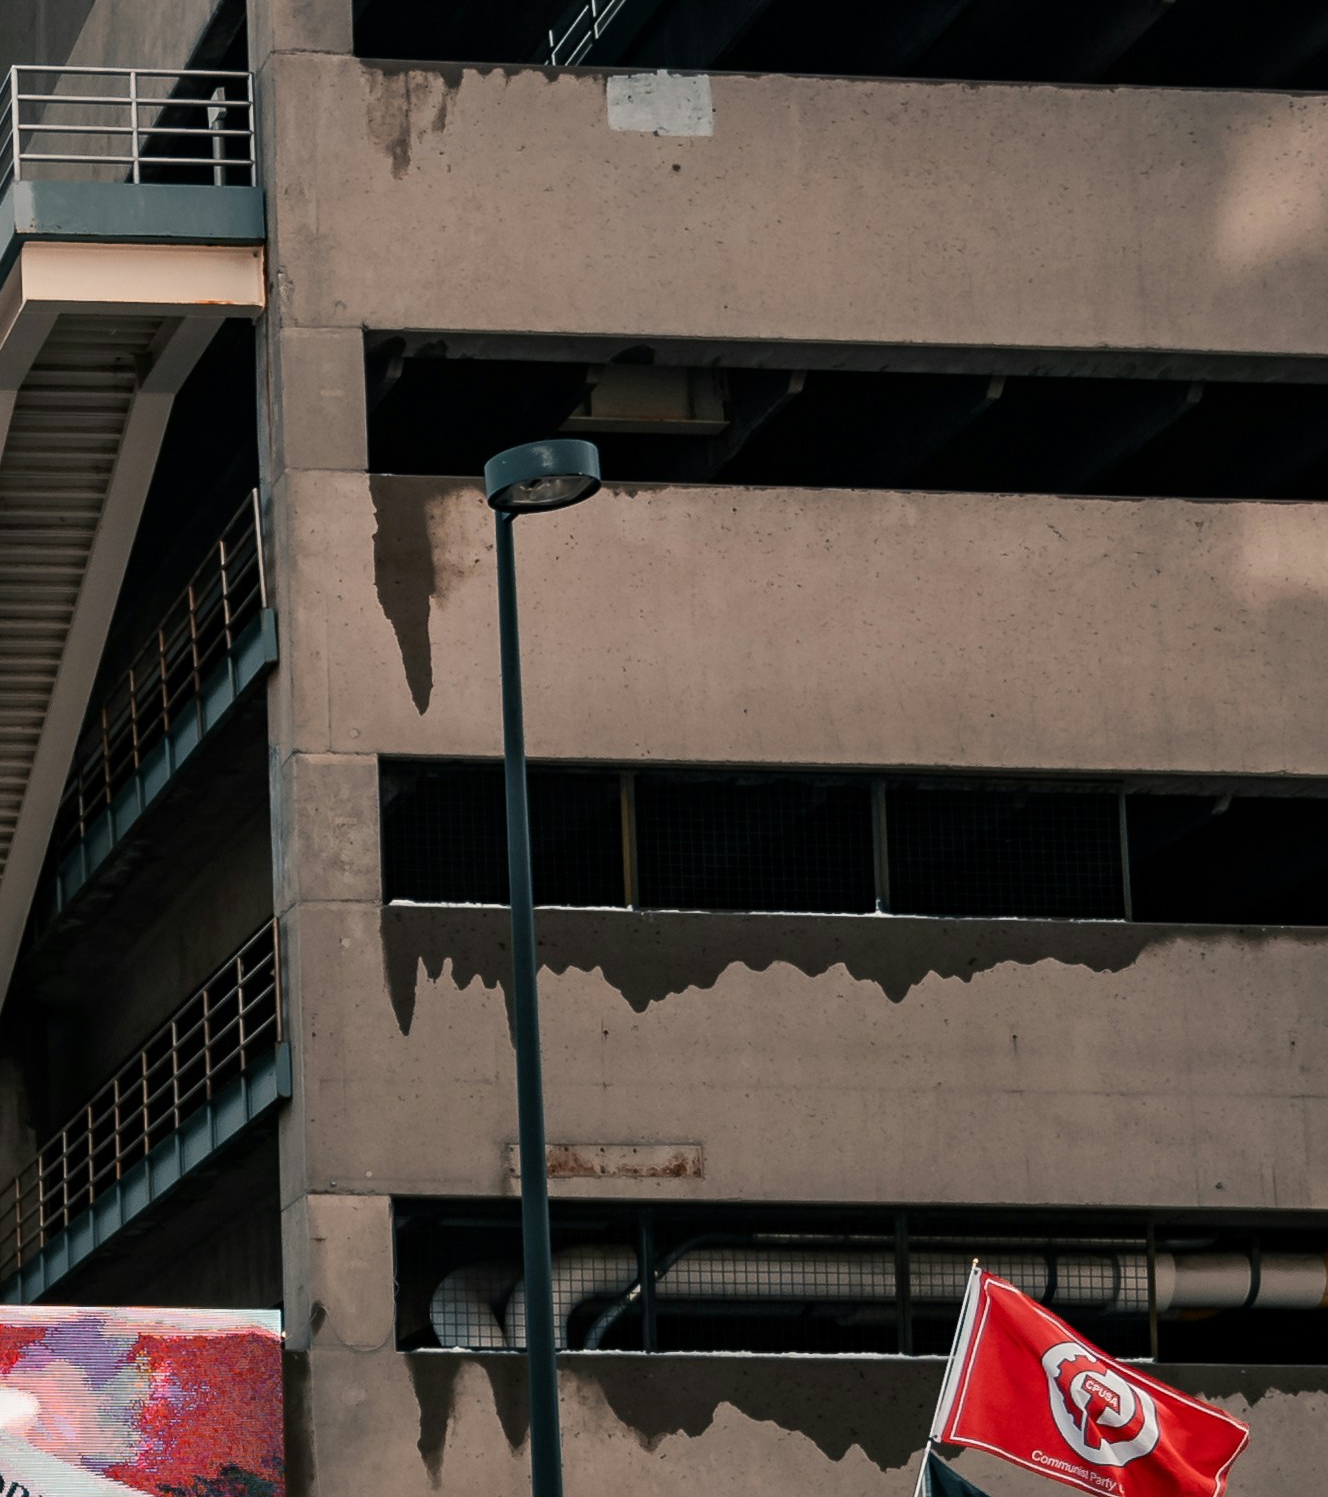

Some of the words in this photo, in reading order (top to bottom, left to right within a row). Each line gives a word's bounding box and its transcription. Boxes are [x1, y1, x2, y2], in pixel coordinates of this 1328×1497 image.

[1085, 1380, 1119, 1407] CPUSA
[1031, 1450, 1089, 1479] Communist
[1090, 1471, 1117, 1492] Party
